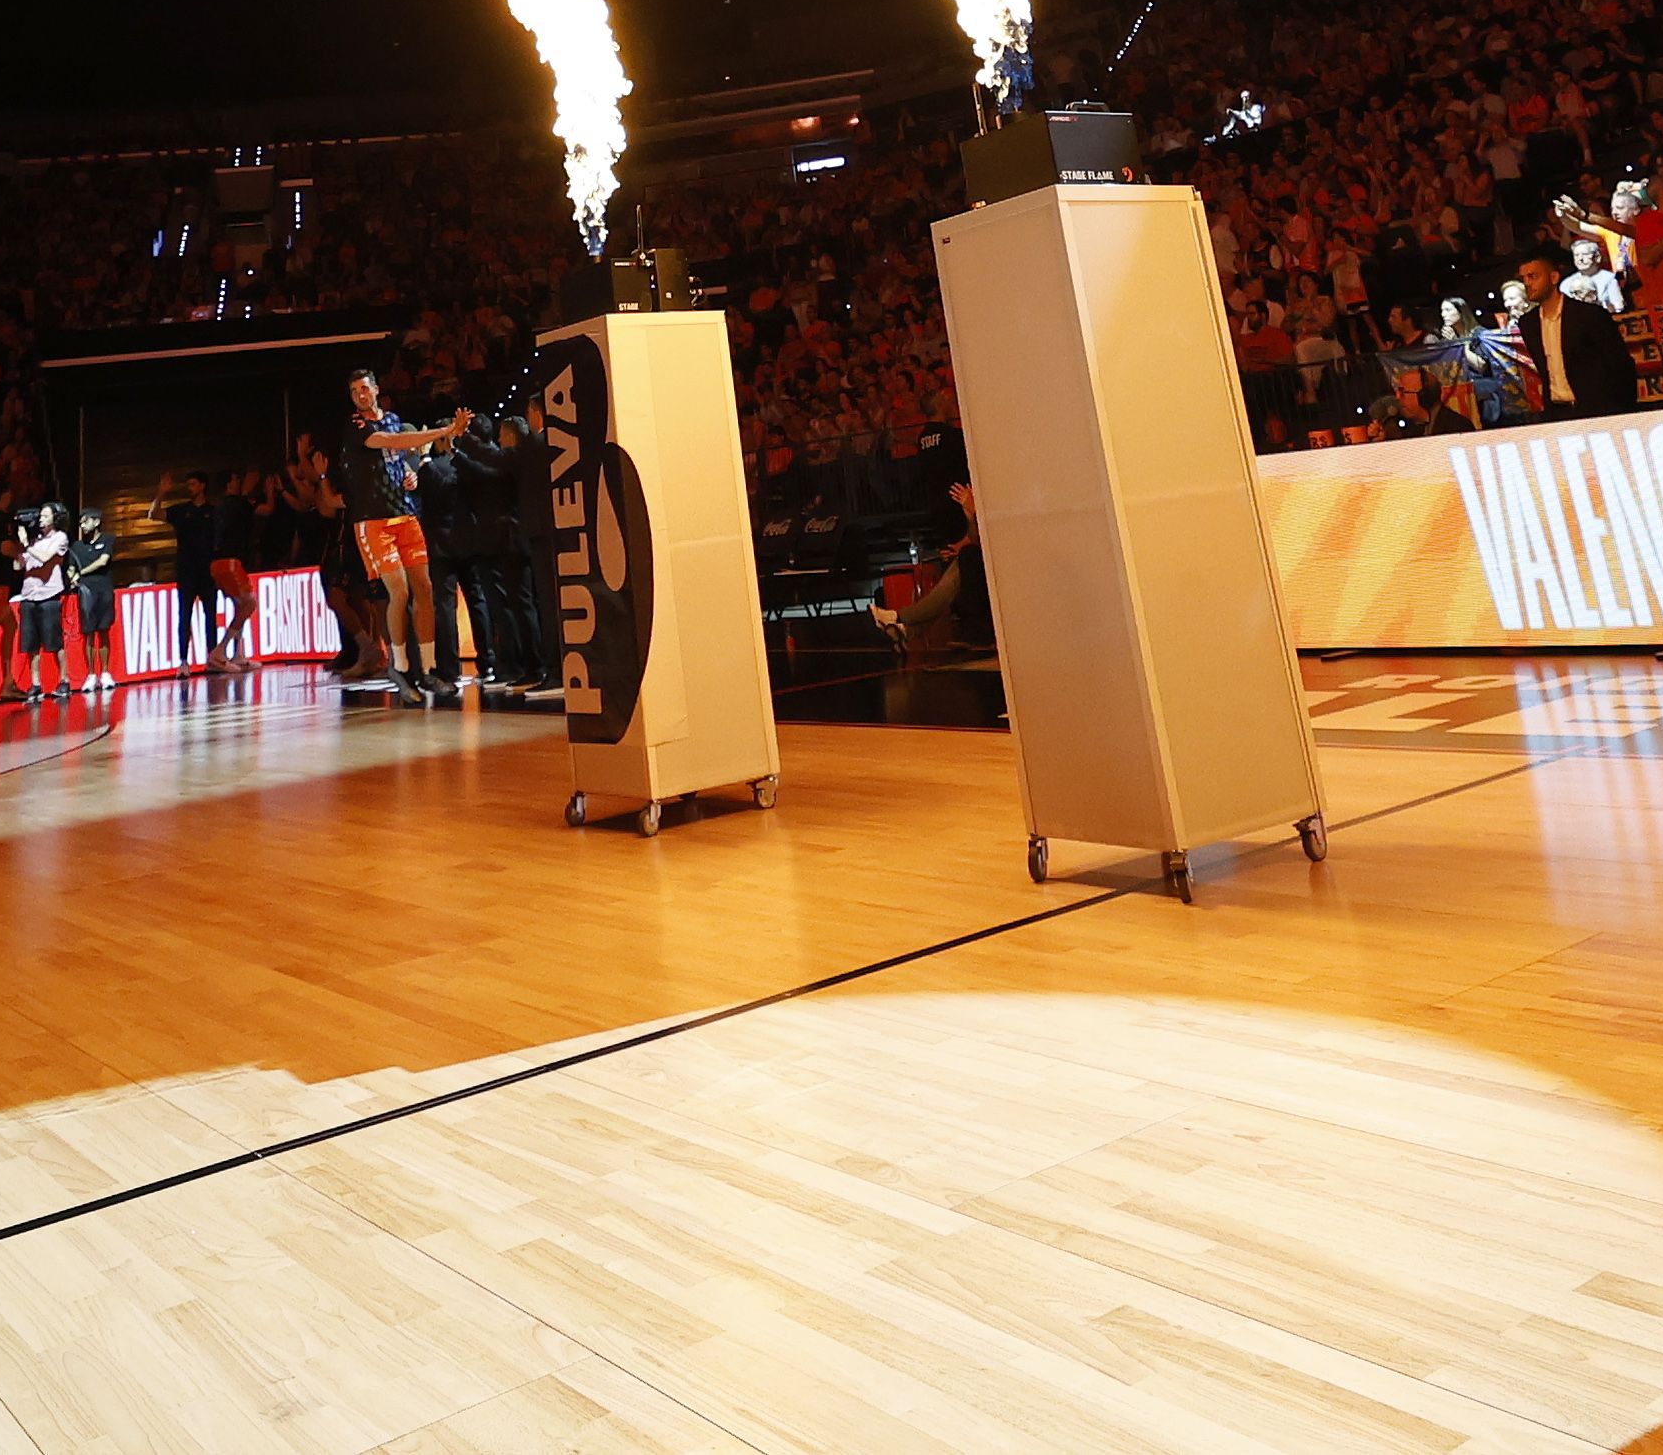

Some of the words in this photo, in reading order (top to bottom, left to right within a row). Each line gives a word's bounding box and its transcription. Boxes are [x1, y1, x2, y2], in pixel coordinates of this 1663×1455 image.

[1088, 170, 1114, 180] FLAME
[920, 433, 942, 450] STAFF
[544, 363, 603, 715] PULEVA
